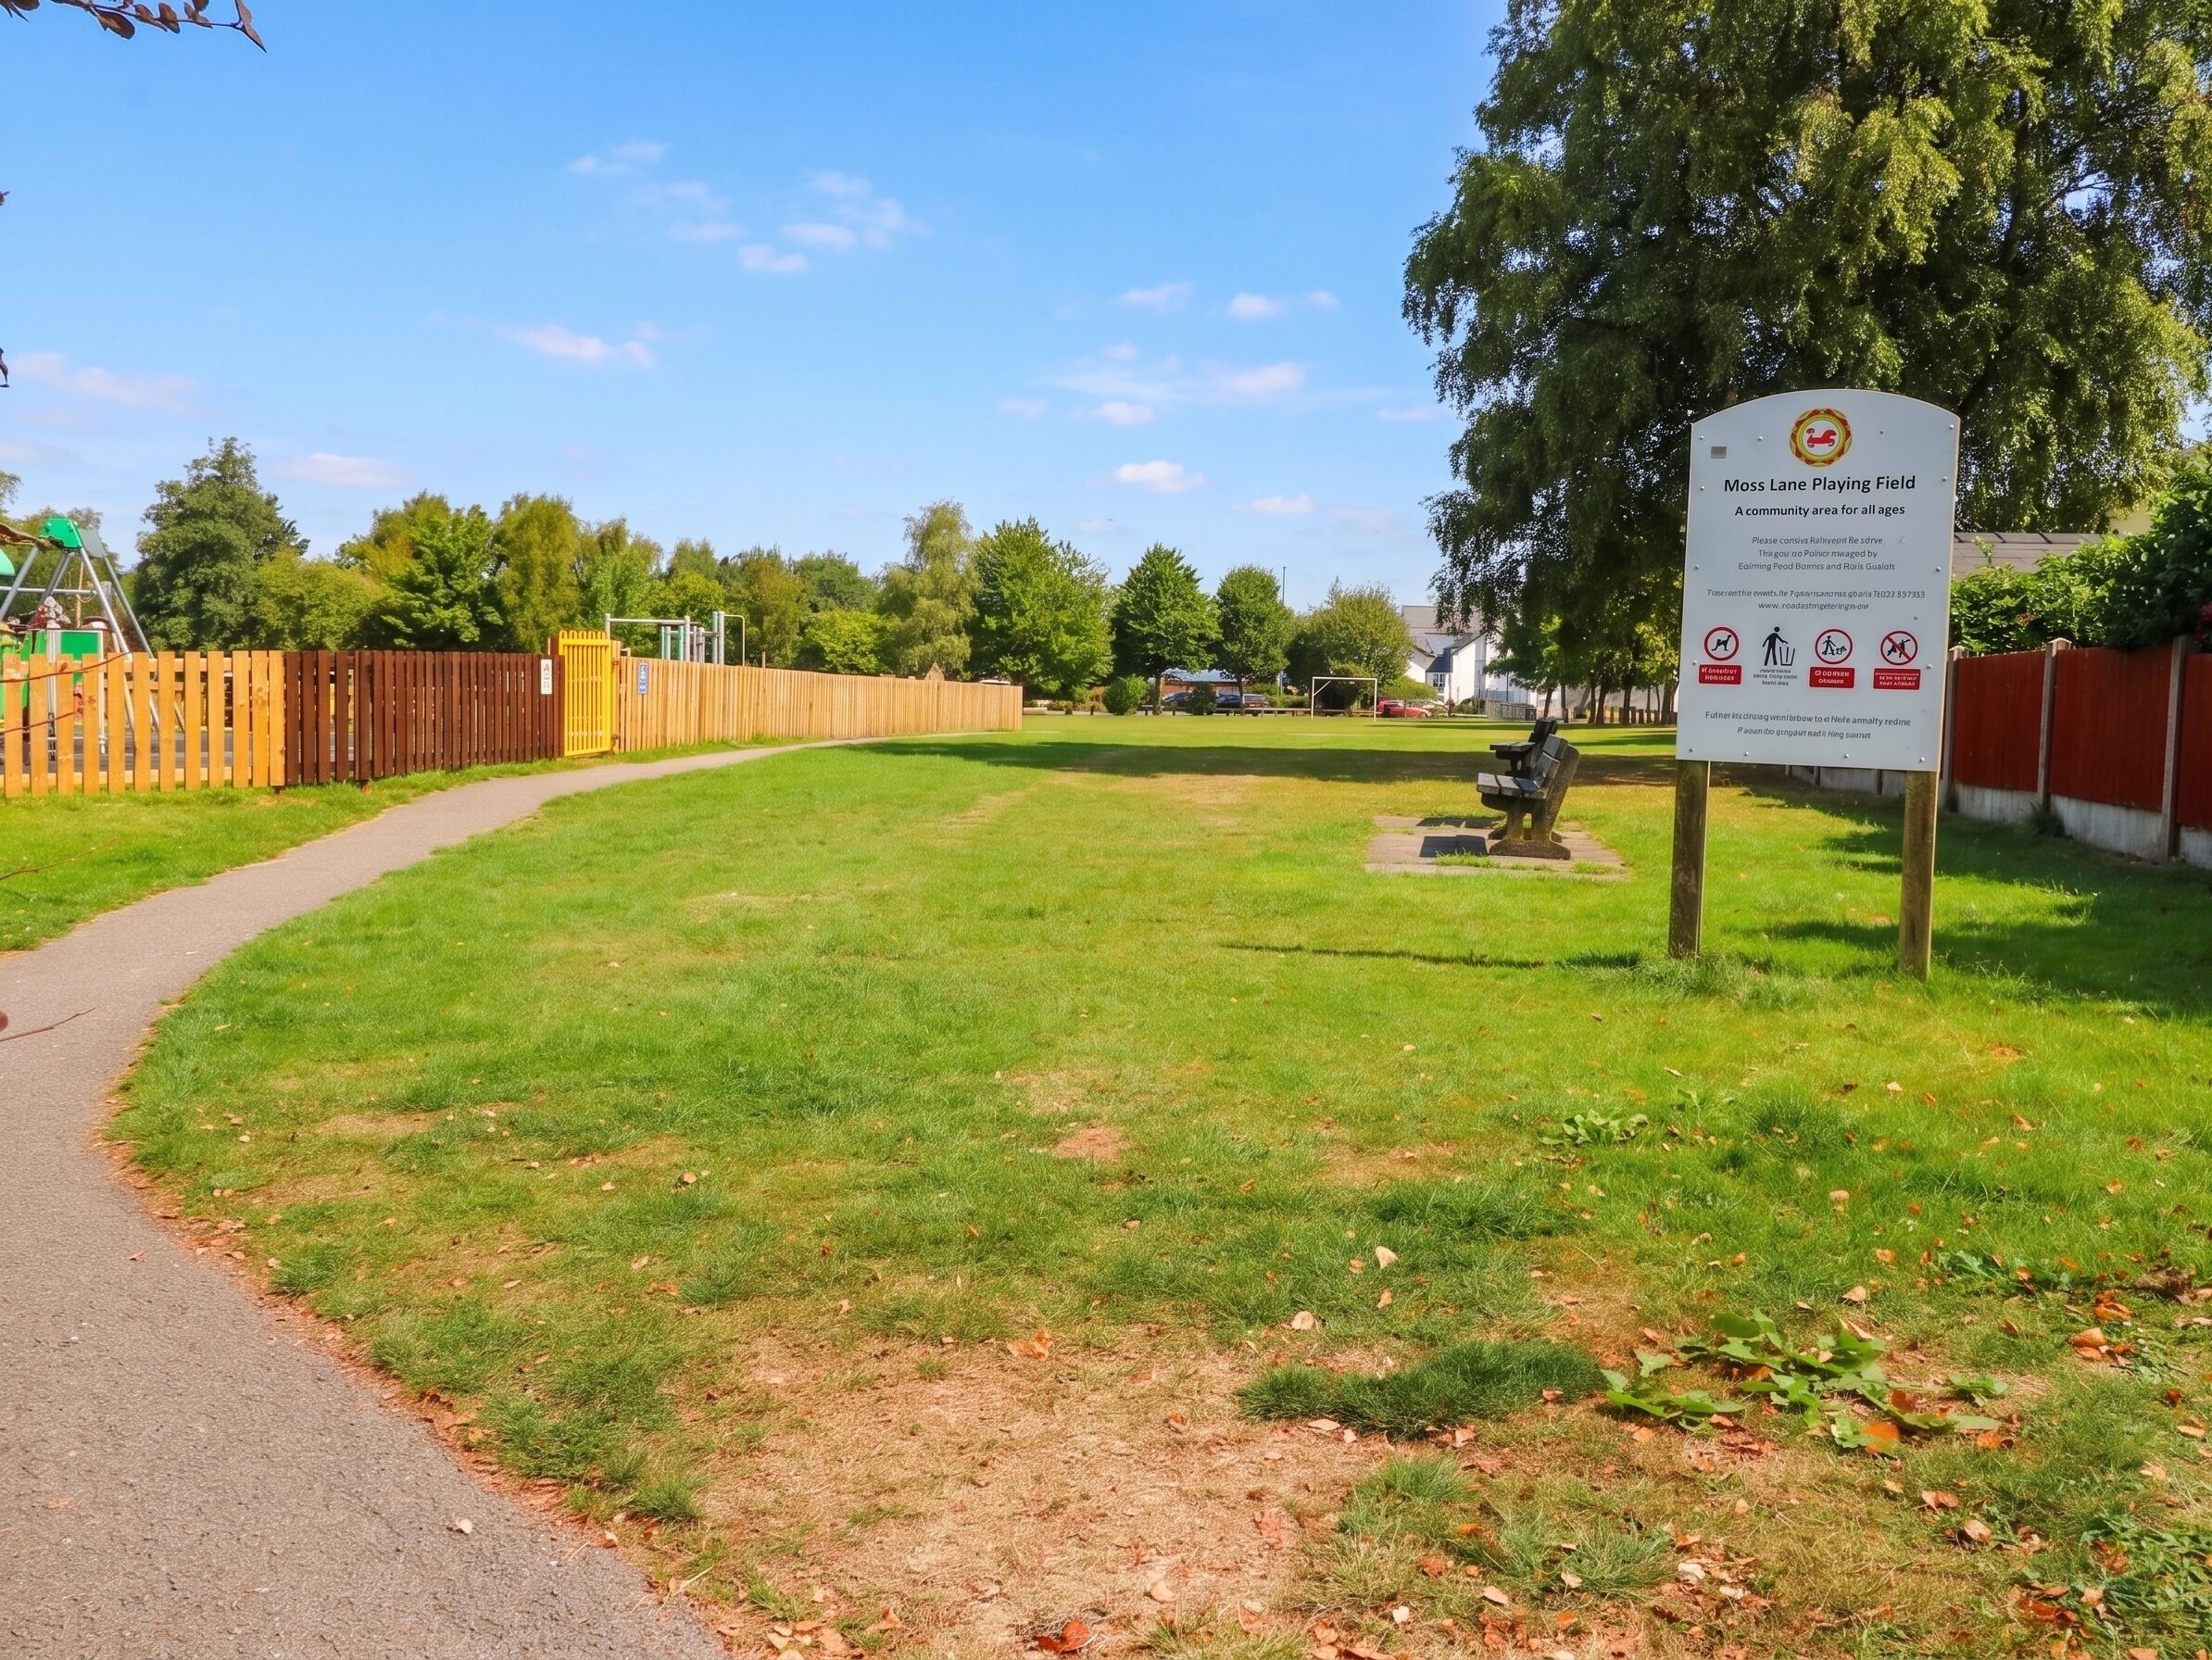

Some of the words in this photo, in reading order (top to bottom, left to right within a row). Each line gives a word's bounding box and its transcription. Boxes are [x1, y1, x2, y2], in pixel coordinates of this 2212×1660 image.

[1725, 479, 1765, 492] Moss
[1770, 478, 1806, 491] Lane
[1813, 477, 1870, 493] Playing
[1877, 475, 1916, 489] Field
[1735, 506, 1743, 516] A
[1746, 505, 1809, 518] community
[1812, 507, 1838, 515] area
[1841, 504, 1858, 514] for
[1861, 504, 1875, 514] all
[1878, 505, 1904, 517] ages
[1752, 536, 1778, 545] Please
[1867, 549, 1878, 559] by
